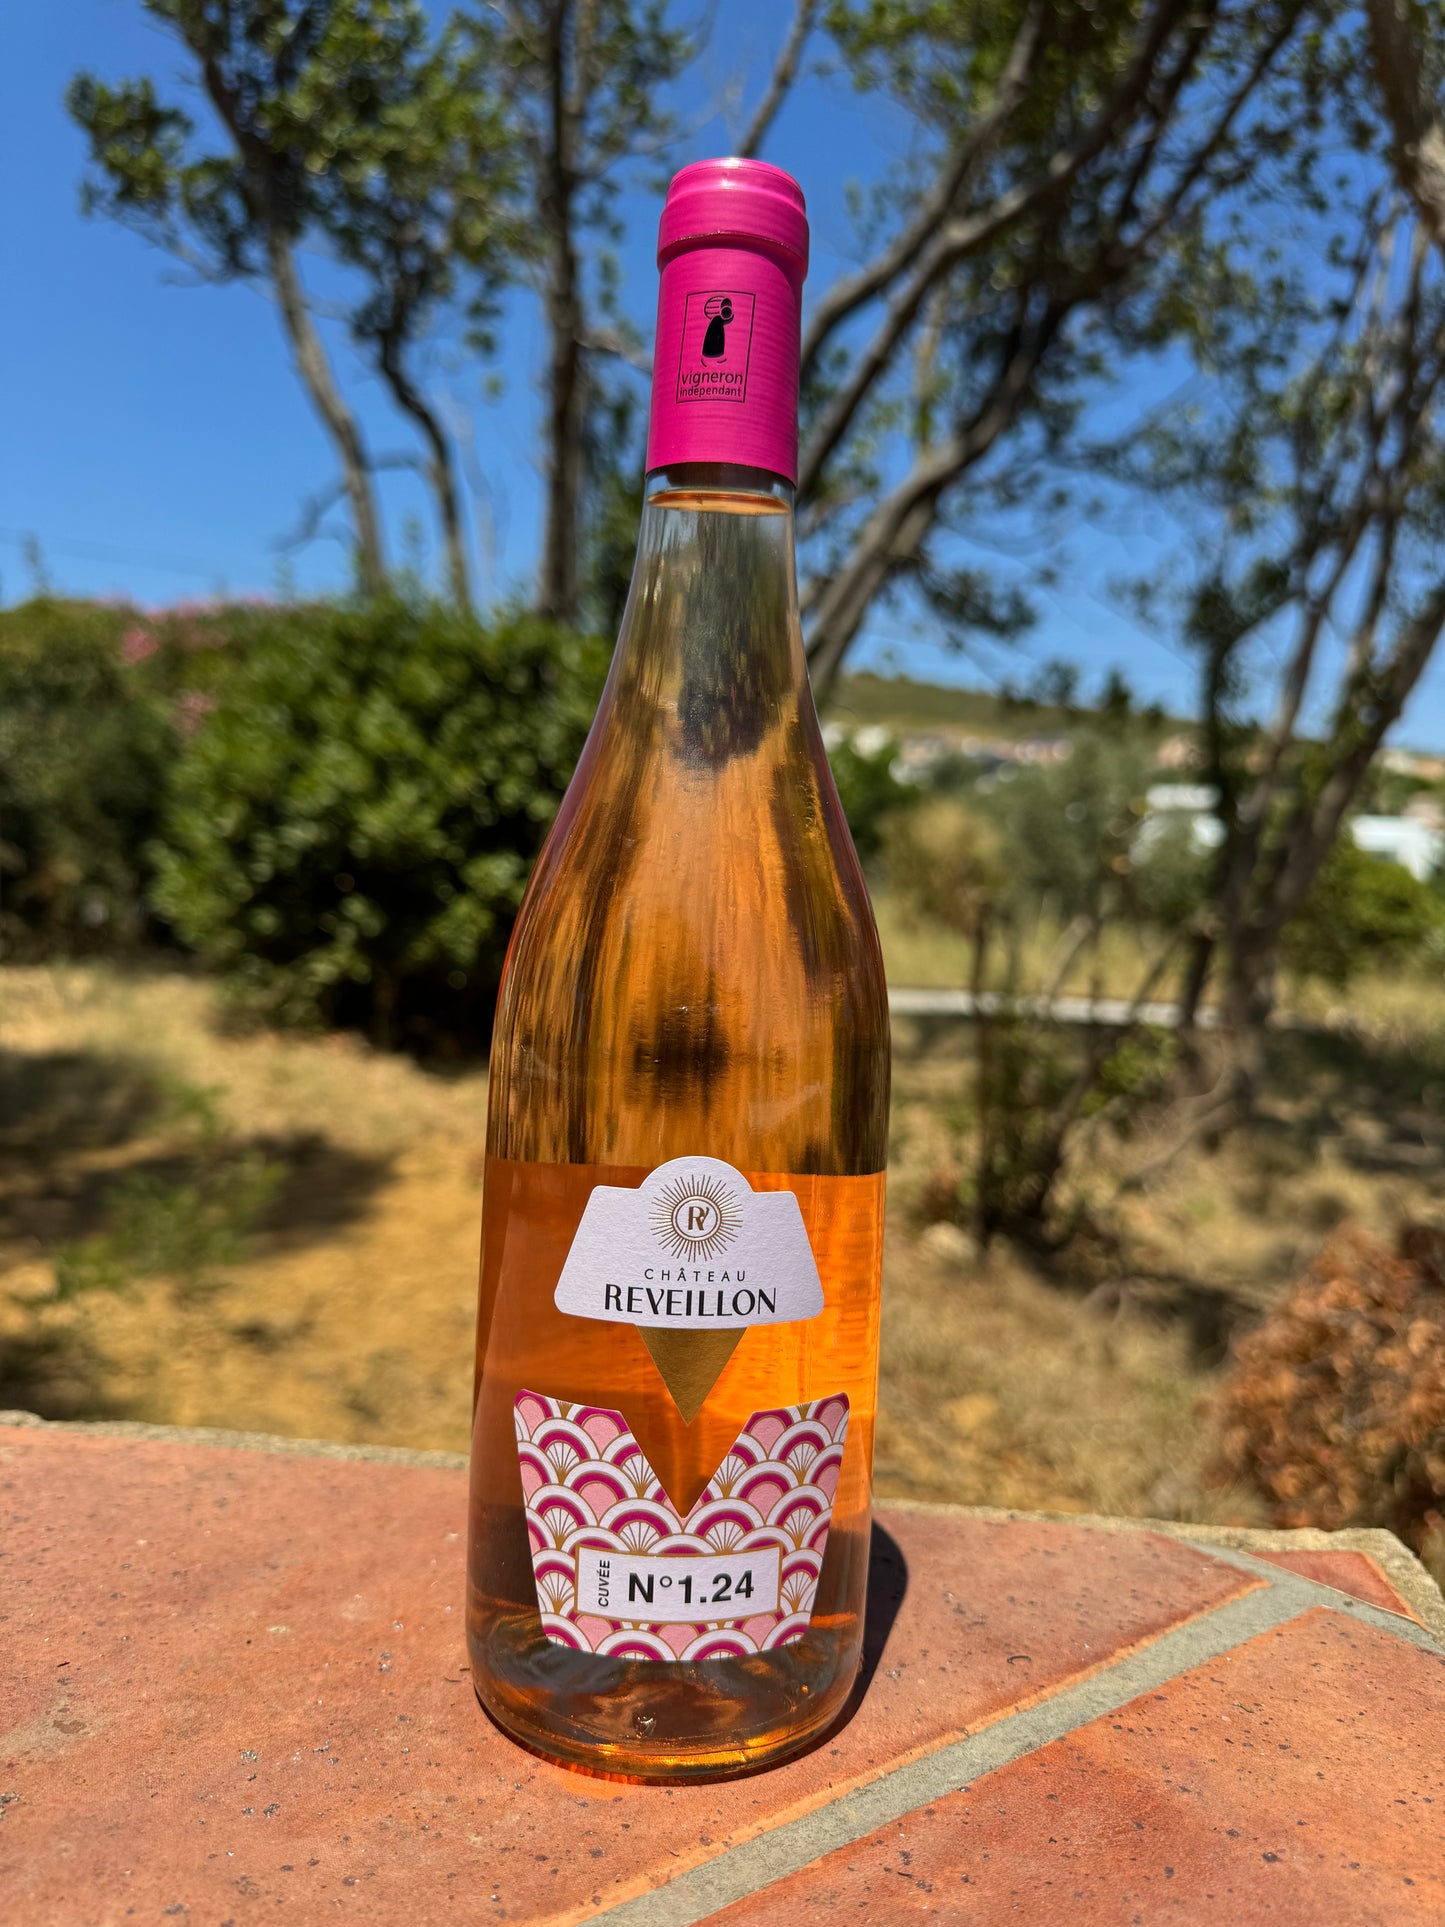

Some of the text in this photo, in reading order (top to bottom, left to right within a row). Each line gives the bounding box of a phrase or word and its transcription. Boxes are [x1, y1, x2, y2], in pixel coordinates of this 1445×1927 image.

[681, 370, 743, 387] vigneron
[644, 1267, 746, 1282] CHÂTEAU
[604, 1283, 776, 1317] REVEILLON
[597, 1559, 611, 1607] CUVÉE
